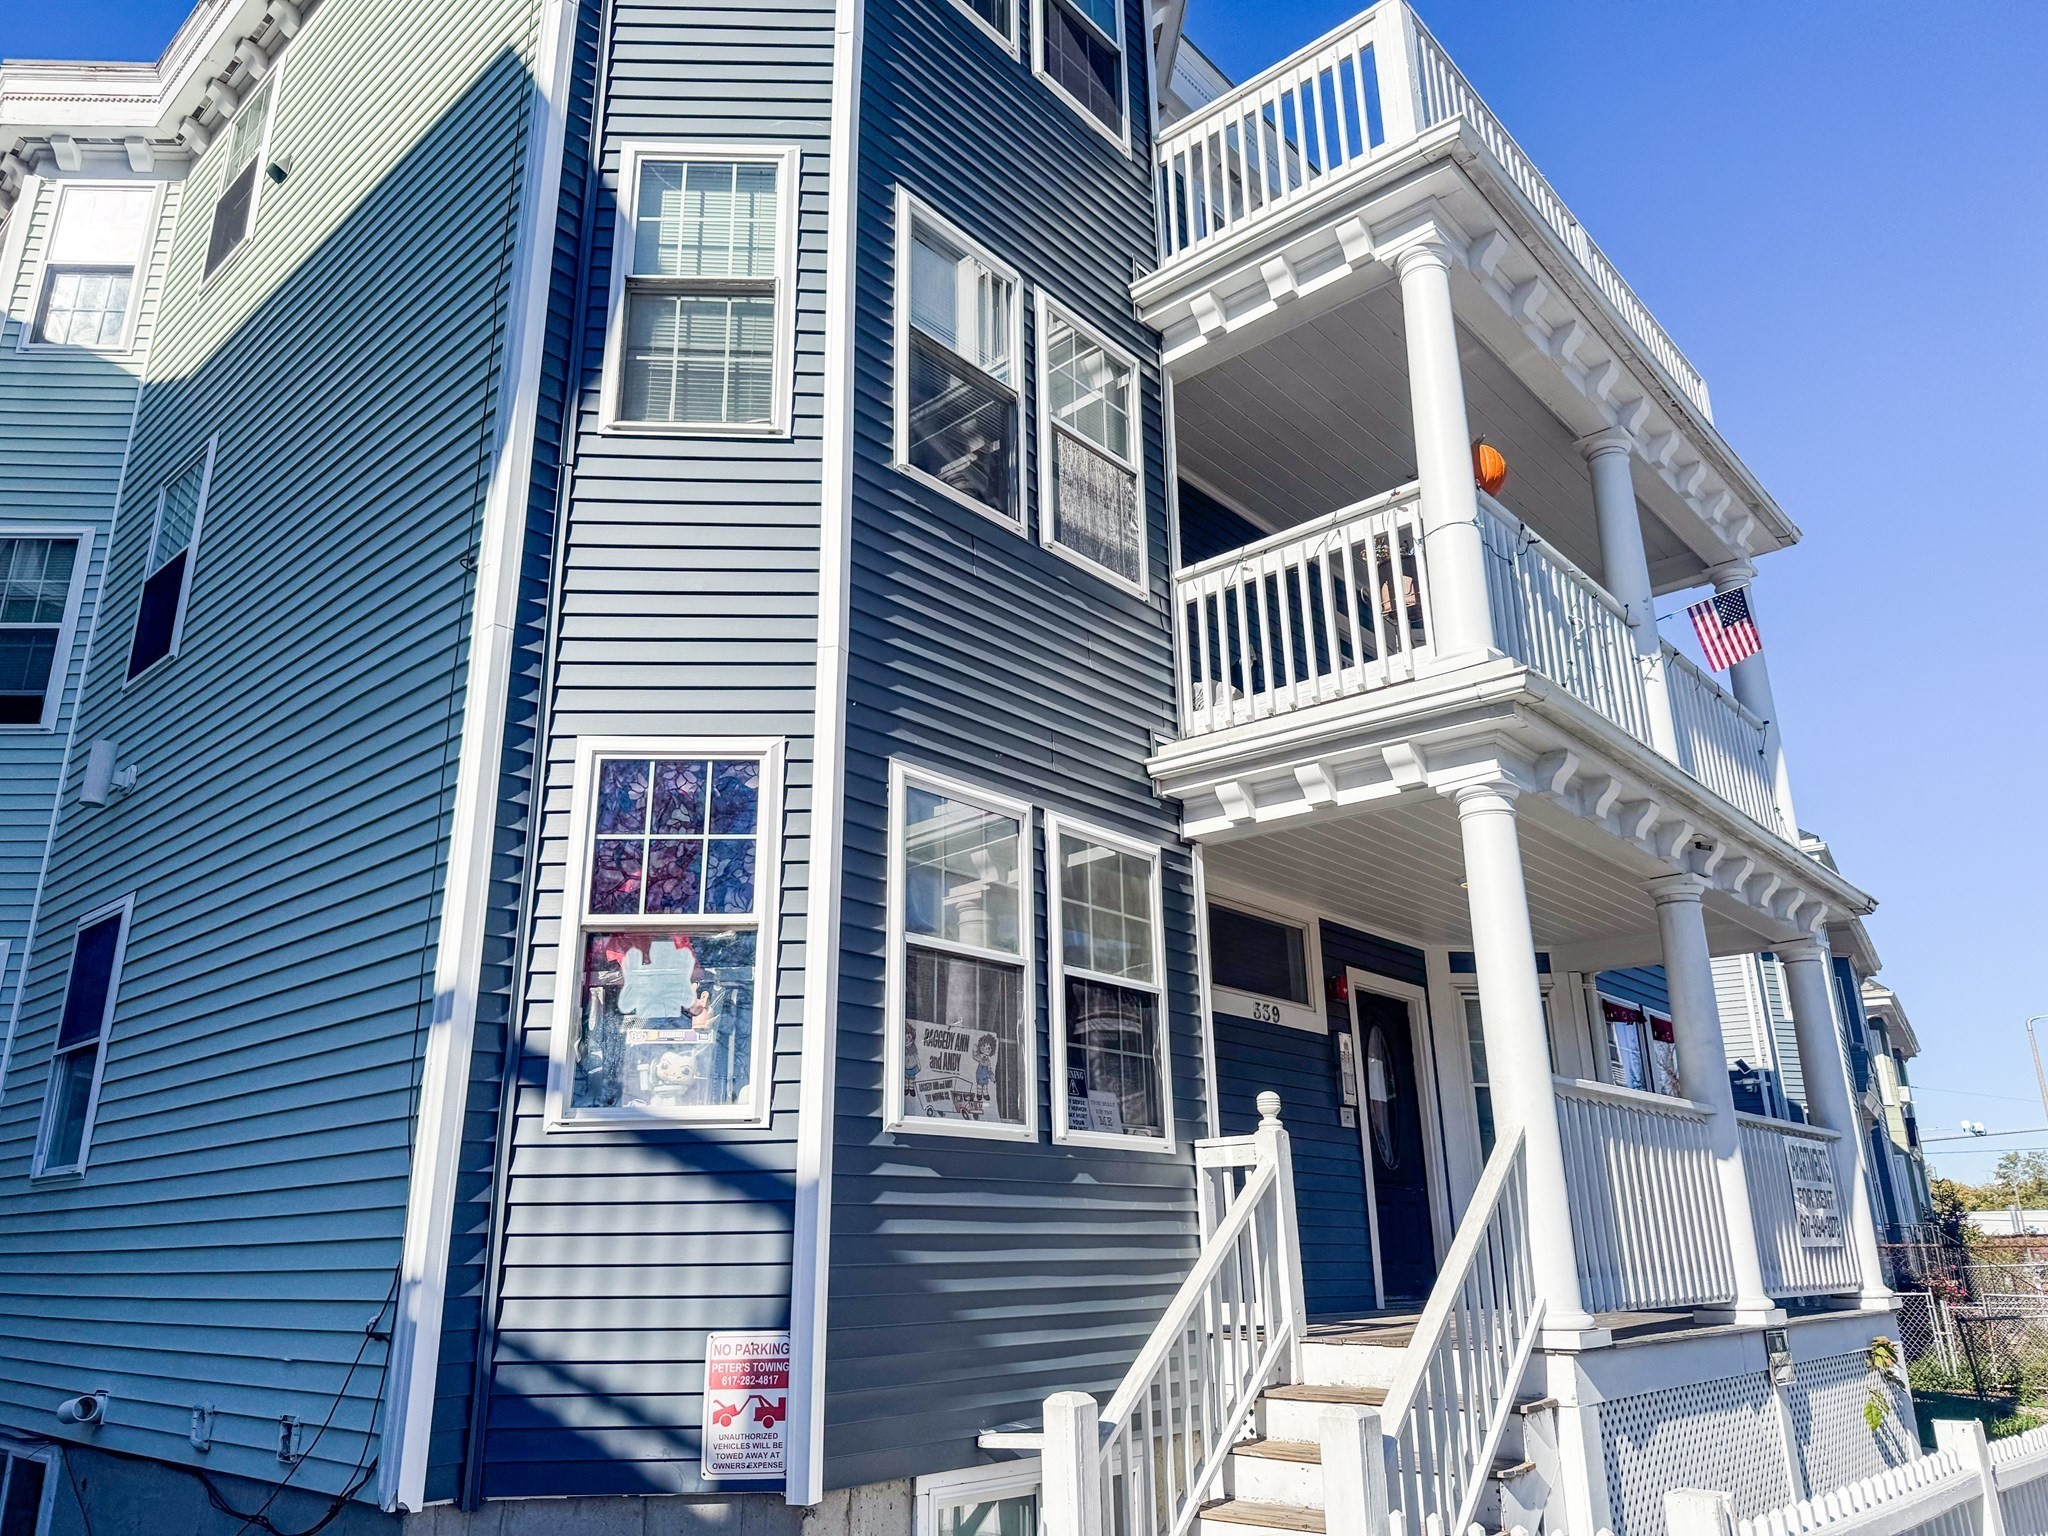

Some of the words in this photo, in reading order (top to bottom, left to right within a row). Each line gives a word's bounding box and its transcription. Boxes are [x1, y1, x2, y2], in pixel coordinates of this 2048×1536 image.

[1253, 1001, 1280, 1023] 339
[924, 1028, 955, 1050] RAGGEDY
[955, 1032, 970, 1052] ANN
[929, 1051, 943, 1070] and
[943, 1052, 961, 1071] ANDY
[1067, 1069, 1084, 1080] NING
[1788, 1144, 1832, 1184] APARTMENTS
[1797, 1187, 1814, 1209] FOR
[1814, 1190, 1834, 1210] RENT
[714, 1344, 731, 1356] NO
[735, 1342, 790, 1356] PARKING
[711, 1362, 750, 1373] PETER'S
[752, 1361, 790, 1372] TOWING
[721, 1375, 779, 1386] 617-282-4817
[718, 1432, 779, 1441] UNAUTHORIZED
[712, 1442, 751, 1450] VEHICLES
[752, 1442, 771, 1450] WILL
[772, 1441, 783, 1449] BE
[715, 1452, 744, 1460] TOWED
[744, 1451, 769, 1460] AWAY
[769, 1451, 781, 1459] AT
[711, 1462, 746, 1470] OWNERS
[748, 1461, 783, 1469] EXPENSE
